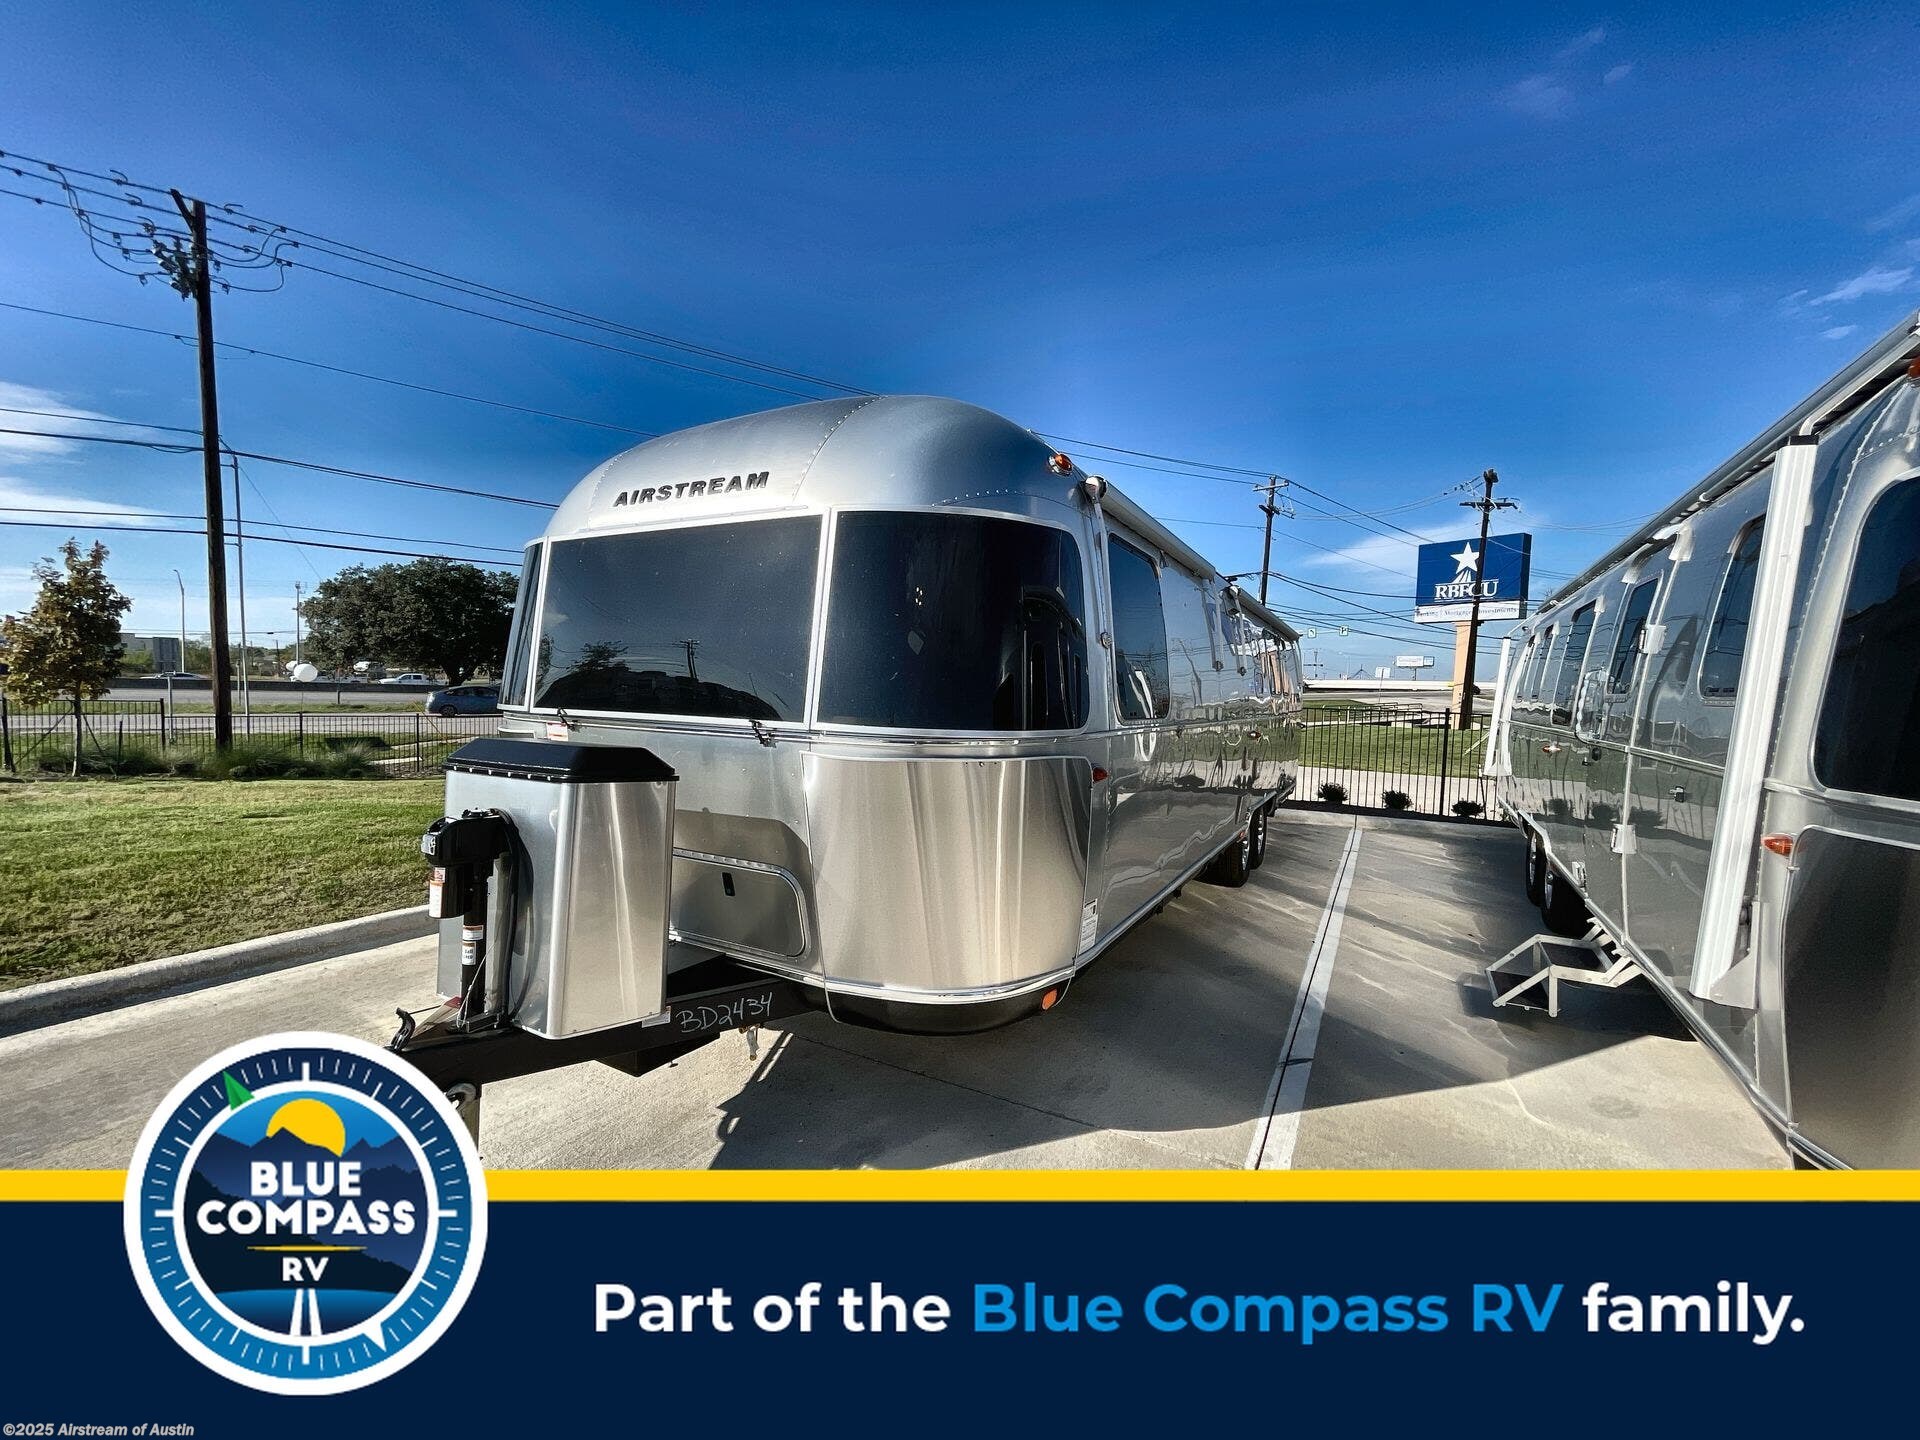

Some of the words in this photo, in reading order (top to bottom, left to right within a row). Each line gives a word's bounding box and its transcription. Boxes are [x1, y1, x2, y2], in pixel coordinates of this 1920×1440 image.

[613, 471, 770, 507] AIRSTREAM
[1434, 580, 1498, 599] RBFCU
[675, 991, 773, 1033] BD2434
